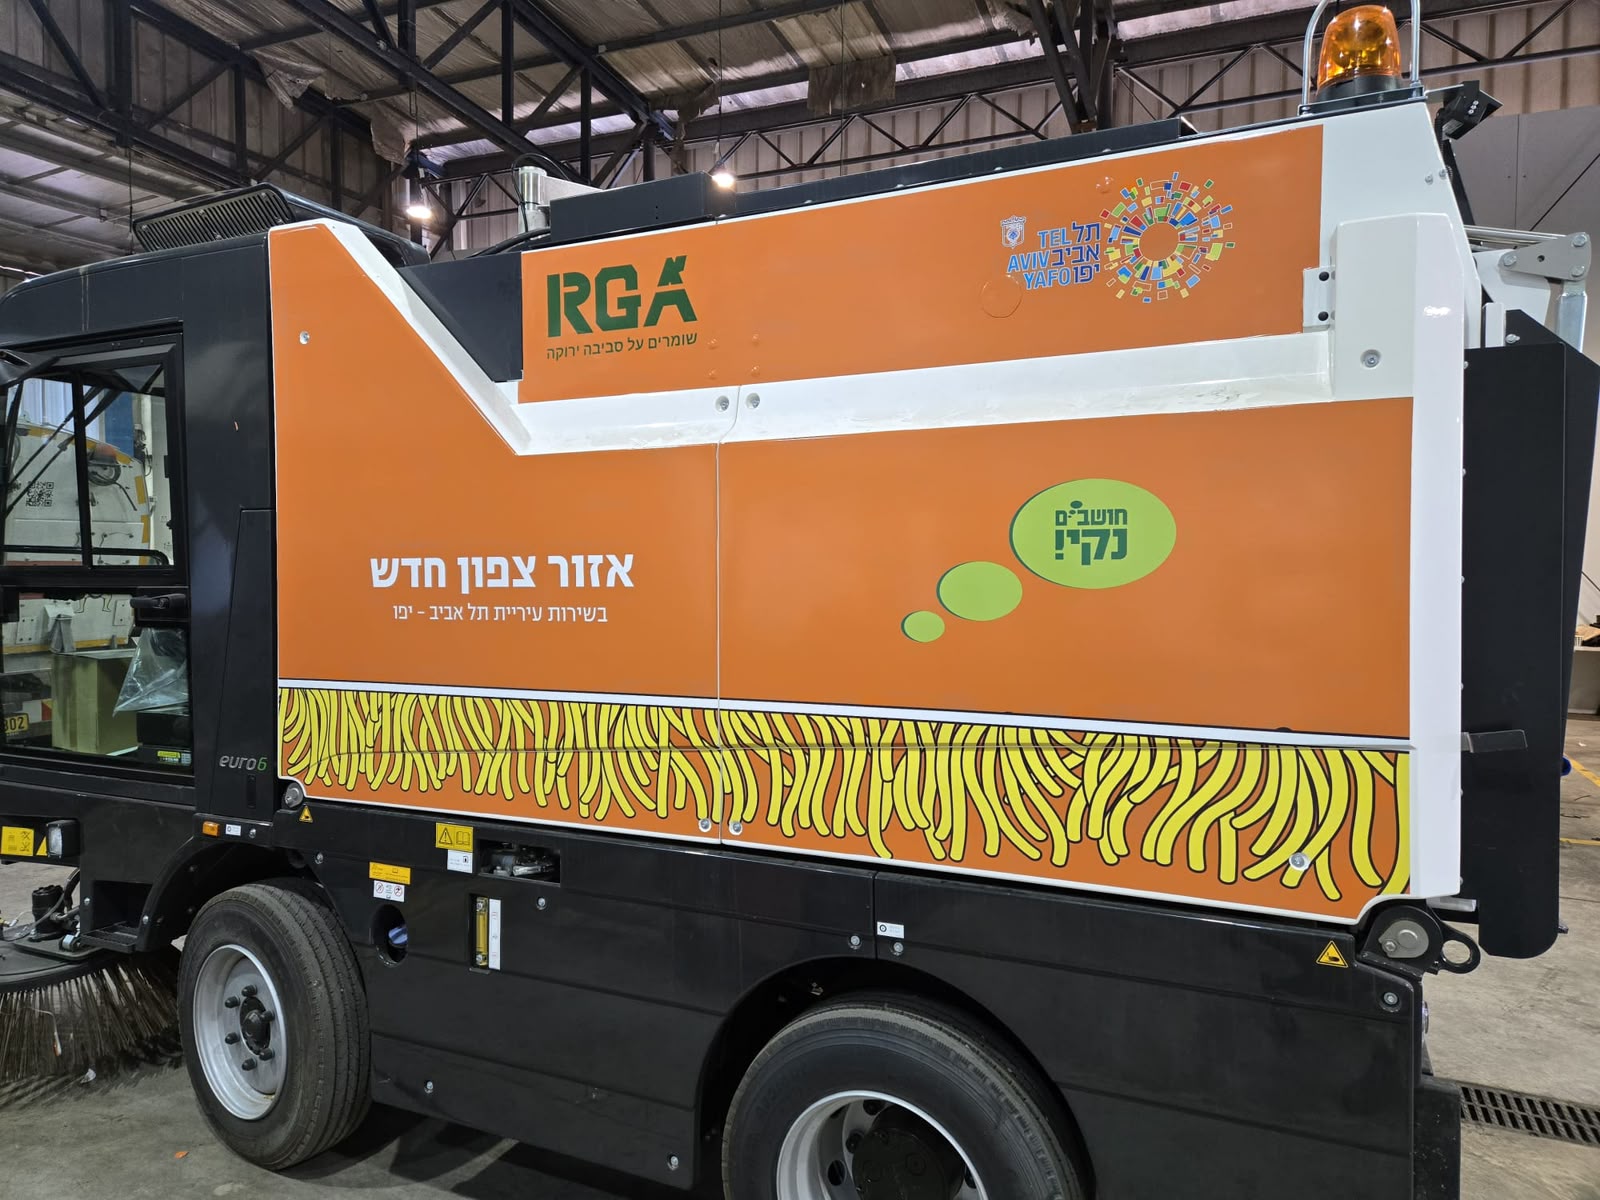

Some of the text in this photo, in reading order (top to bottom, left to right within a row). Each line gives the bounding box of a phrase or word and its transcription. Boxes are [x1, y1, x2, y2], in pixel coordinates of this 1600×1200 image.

[1037, 227, 1072, 249] TEL
[1072, 221, 1101, 243] תל
[1007, 250, 1051, 272] AVIV
[1051, 243, 1100, 266] אביב
[1023, 267, 1071, 290] YAFO
[1073, 263, 1101, 283] יפו
[547, 255, 698, 338] RGA
[546, 333, 698, 361] שומרים על סביבה ירוקה
[370, 553, 634, 595] אזור צפון חדש
[393, 604, 413, 620] יפו
[429, 604, 464, 620] אביב
[467, 603, 489, 620] תל
[493, 605, 543, 622] עיריית
[547, 605, 608, 623] בשירות
